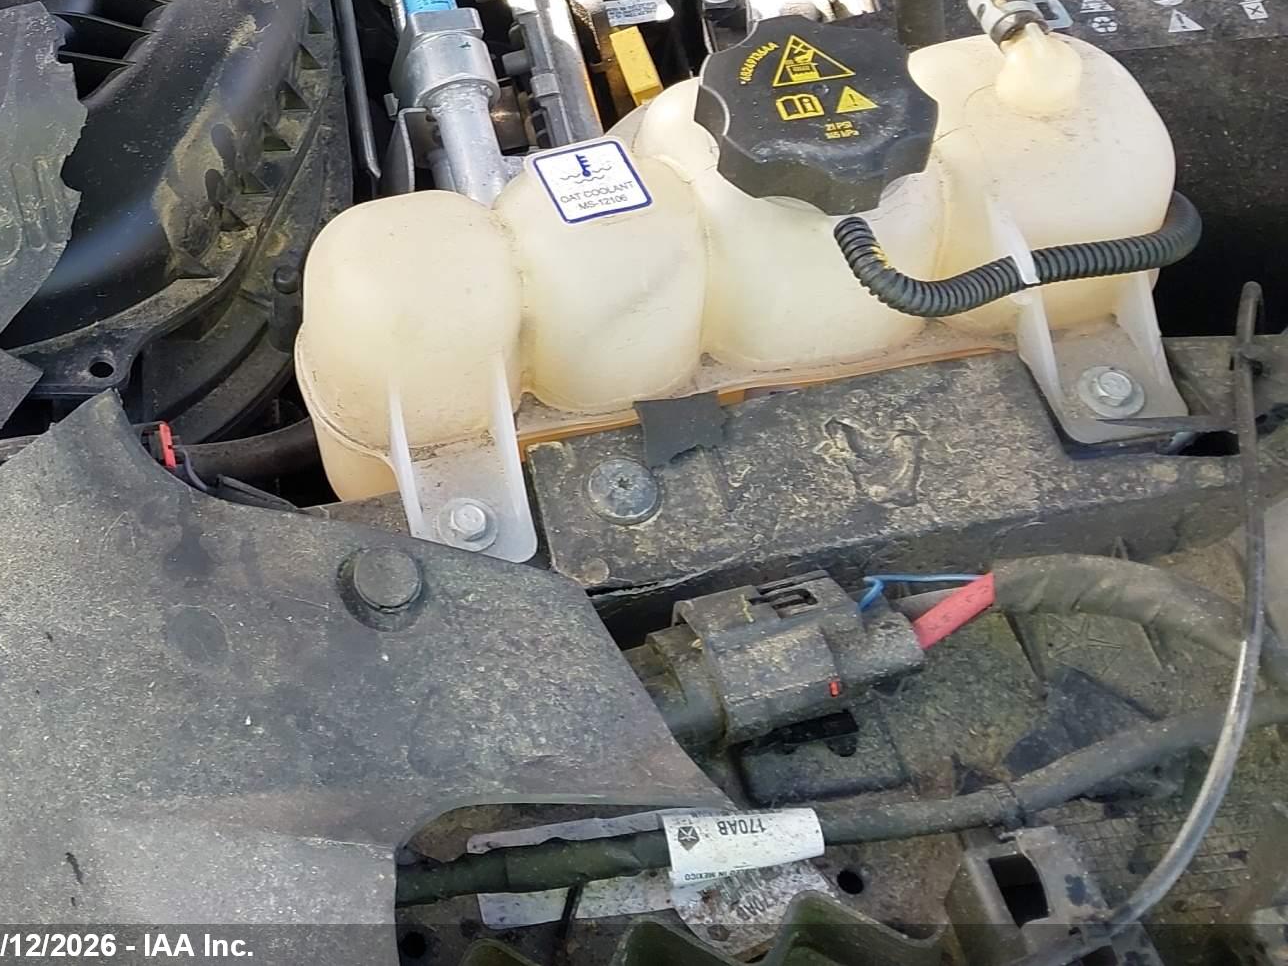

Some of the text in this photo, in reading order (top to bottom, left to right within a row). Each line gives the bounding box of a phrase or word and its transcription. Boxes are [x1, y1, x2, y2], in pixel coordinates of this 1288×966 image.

[560, 180, 634, 204] OAT COOLANT
[578, 194, 628, 210] MS-12106
